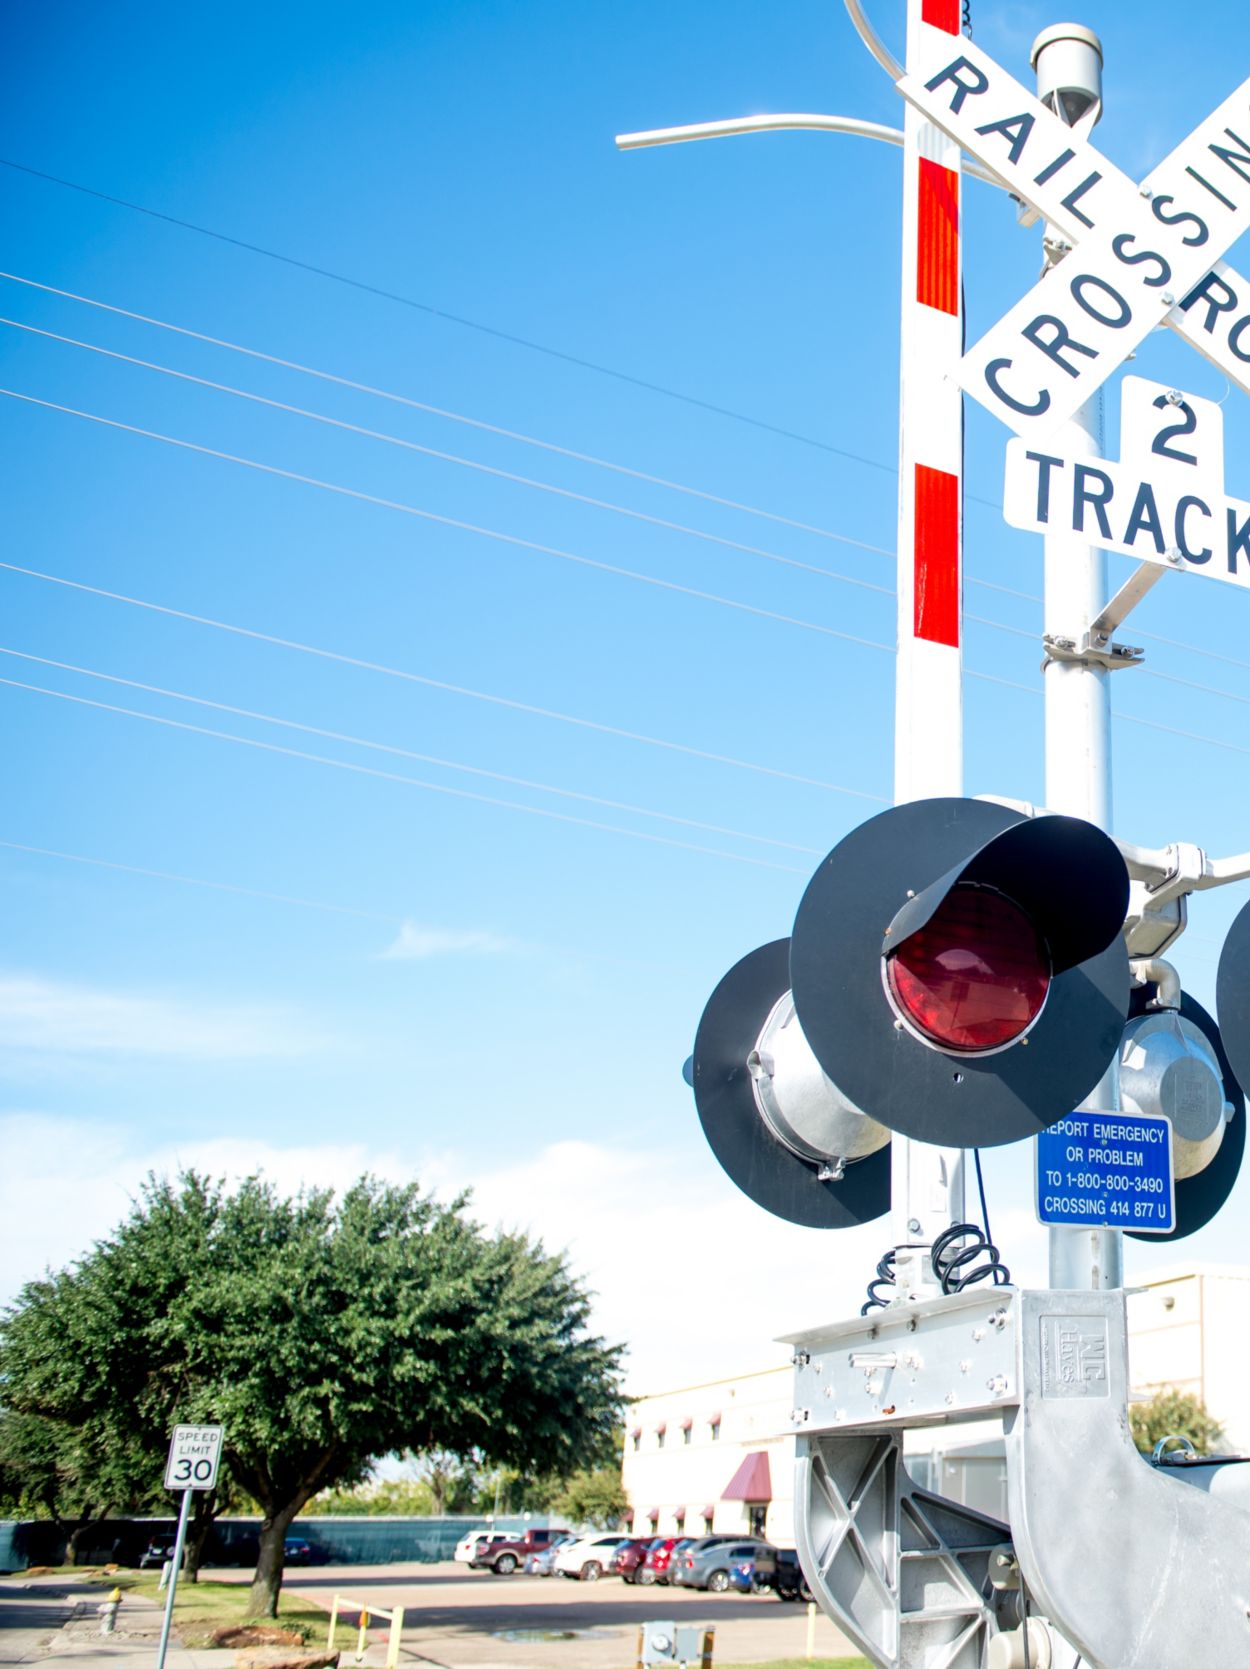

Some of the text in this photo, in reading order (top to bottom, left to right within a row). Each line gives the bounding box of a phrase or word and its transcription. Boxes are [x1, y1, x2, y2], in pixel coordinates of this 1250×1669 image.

[924, 55, 1103, 229] RAIL
[1151, 393, 1198, 466] 2
[1093, 1124, 1165, 1143] EMERGENCY
[1066, 1147, 1143, 1166] OR PROBLEM
[1046, 1171, 1163, 1193] TO 1-800-800-3490
[1044, 1197, 1166, 1218] CROSSING 414 877 U
[1061, 1328, 1079, 1383] Hayes
[177, 1432, 218, 1442] SPEED
[179, 1446, 211, 1455] LIMIT
[174, 1459, 212, 1481] 30
